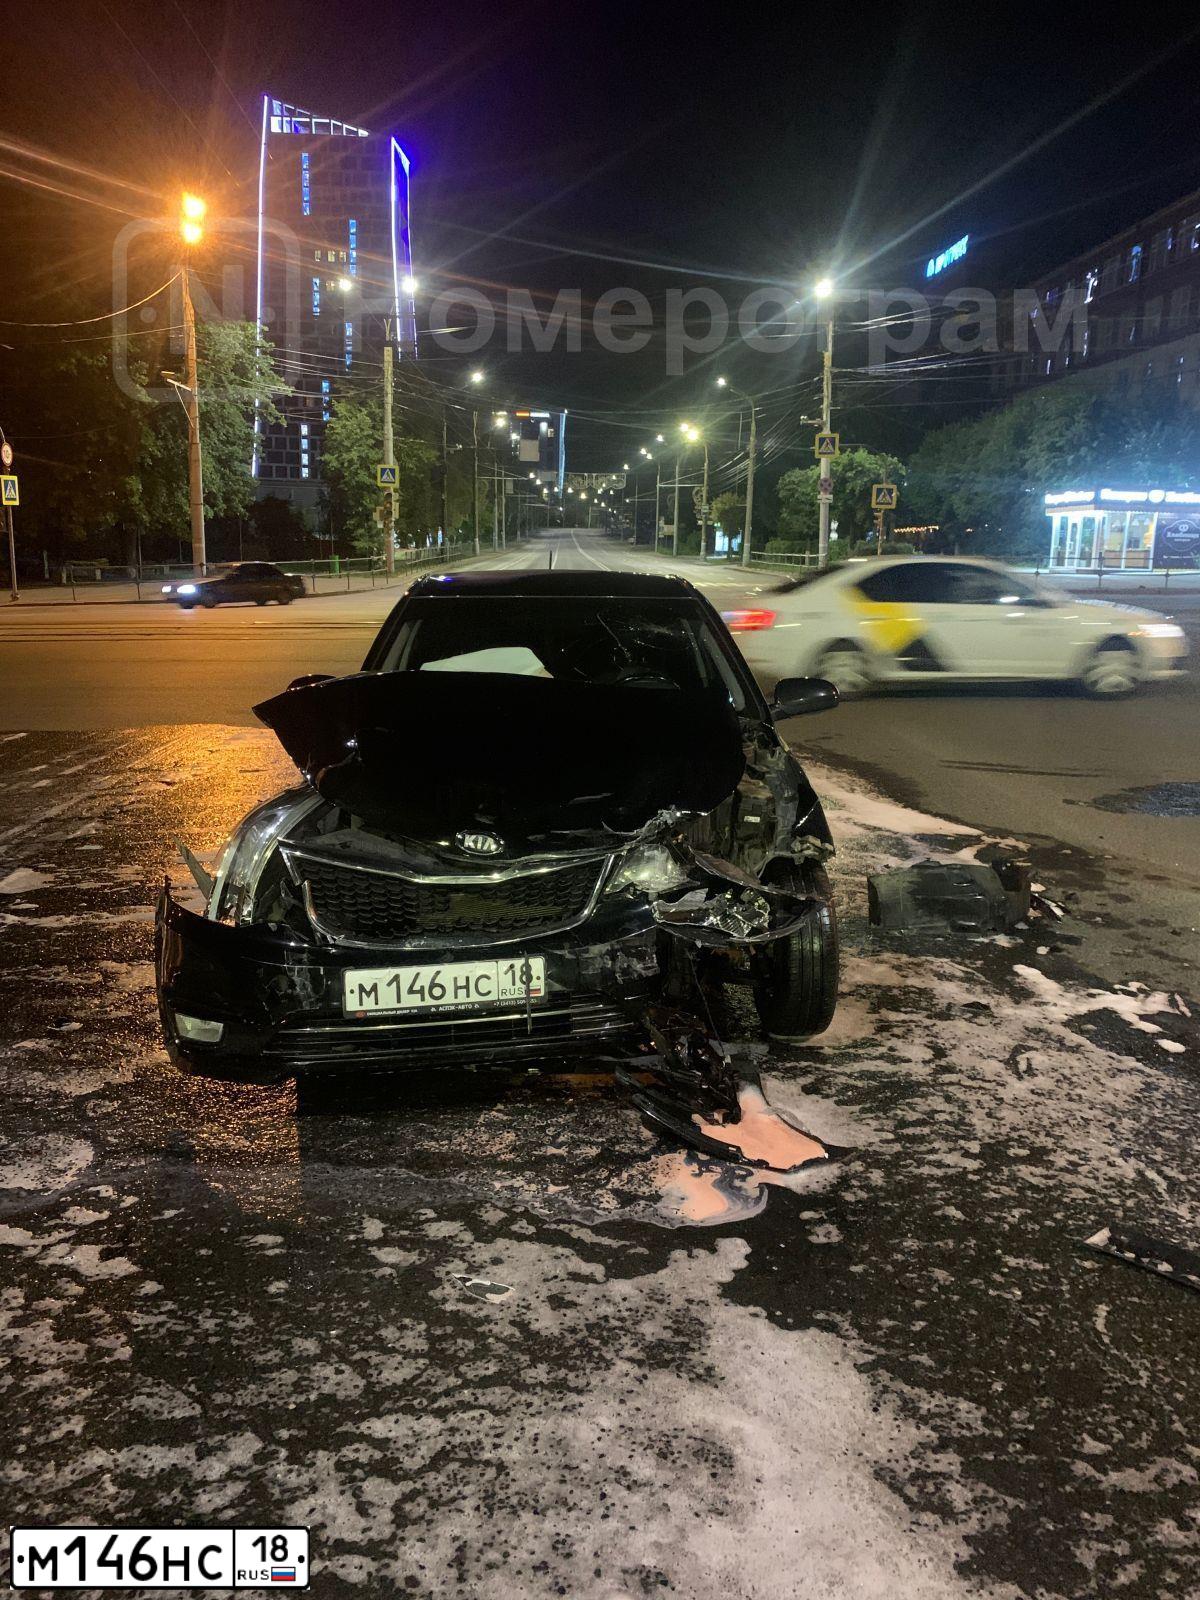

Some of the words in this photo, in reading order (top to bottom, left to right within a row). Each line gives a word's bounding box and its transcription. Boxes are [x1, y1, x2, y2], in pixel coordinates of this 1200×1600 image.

[463, 834, 497, 852] KIA
[358, 970, 492, 1007] М146НС
[504, 963, 533, 986] 18
[500, 988, 524, 998] RUS
